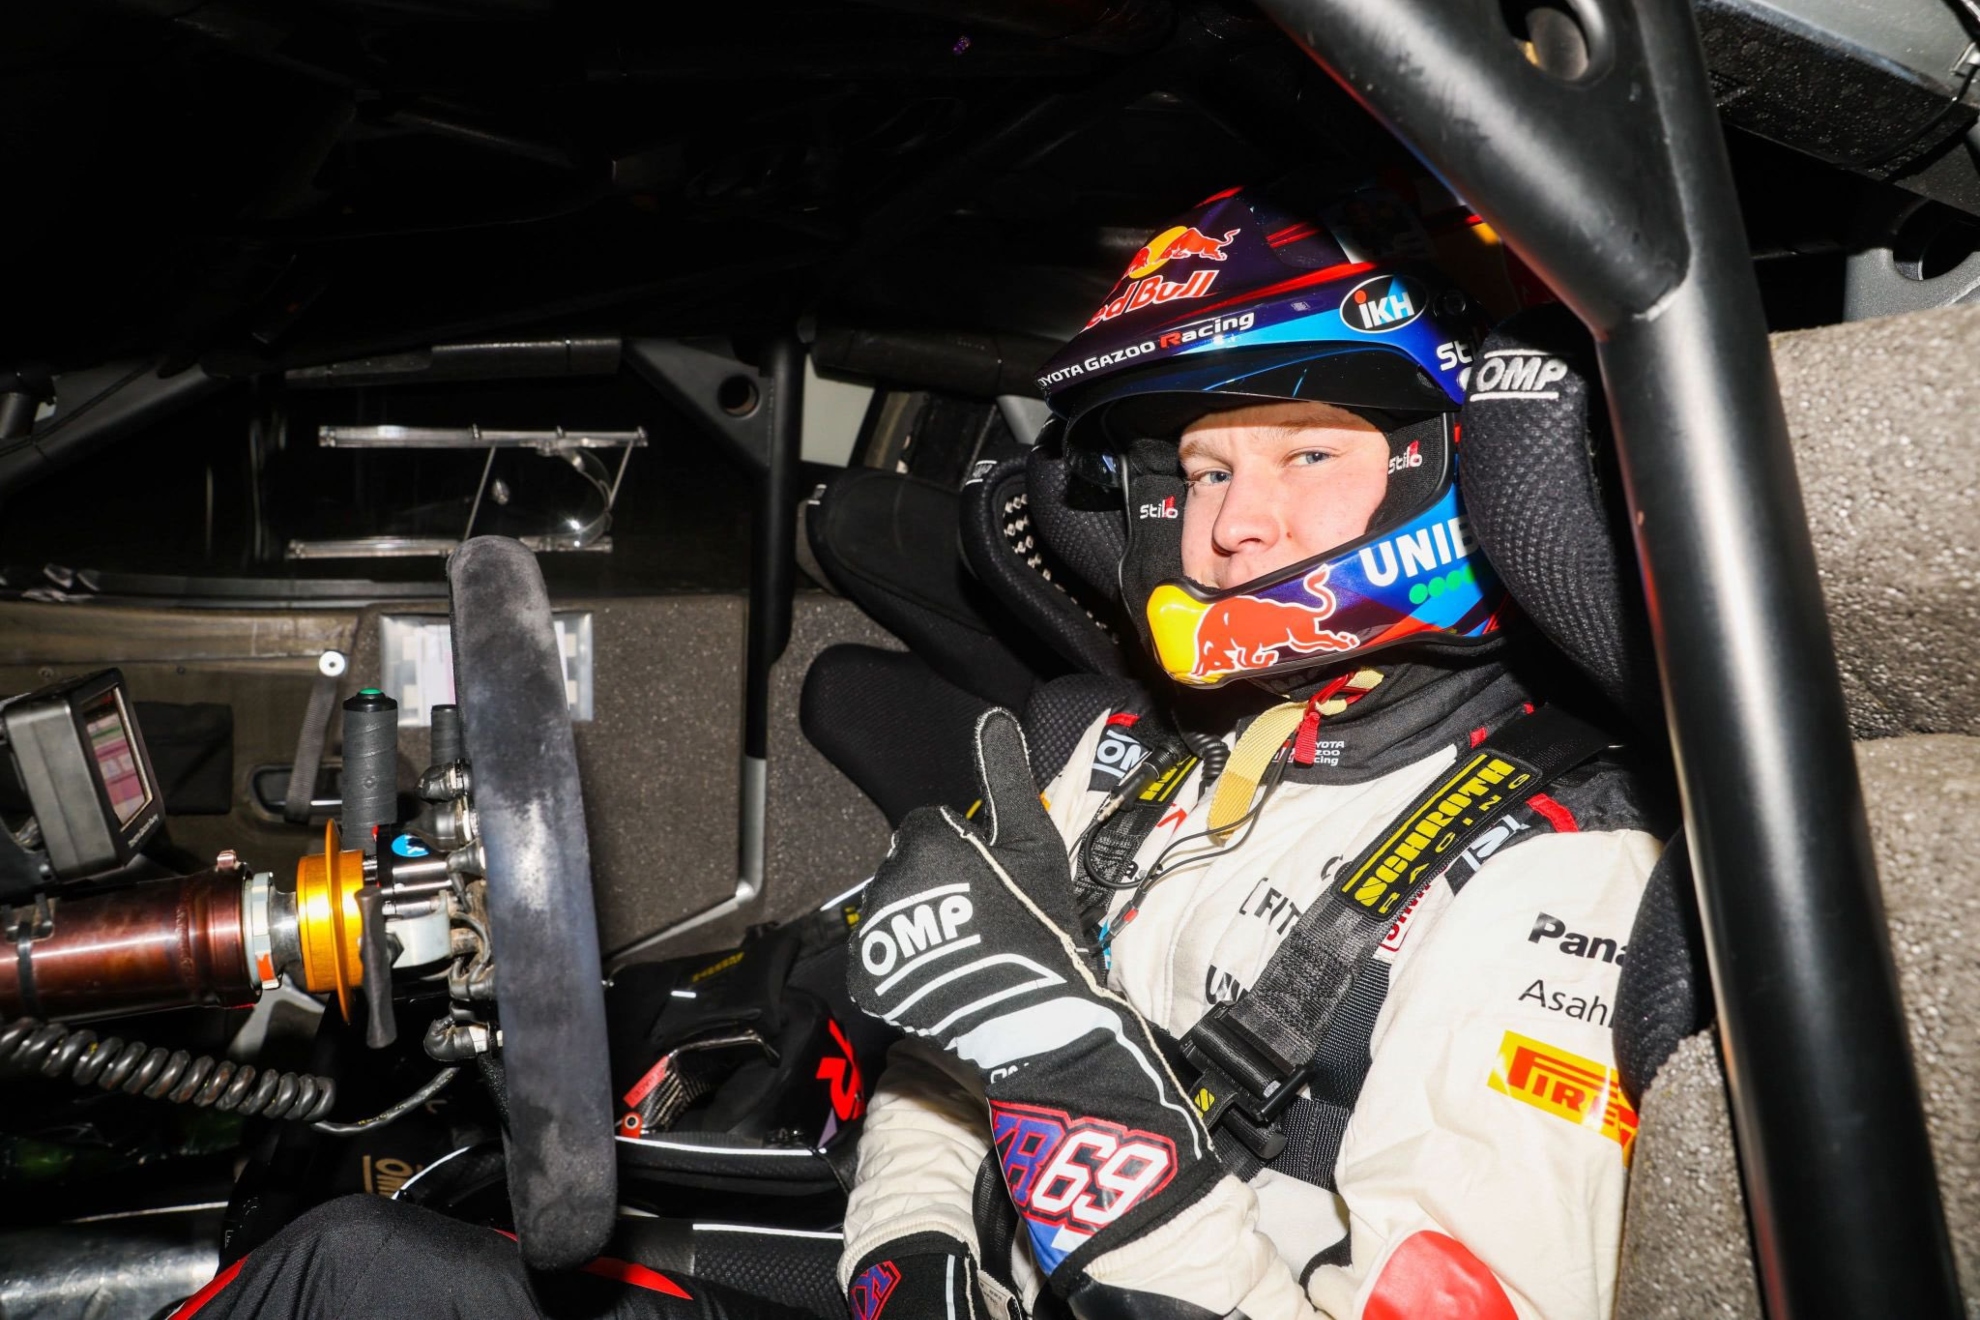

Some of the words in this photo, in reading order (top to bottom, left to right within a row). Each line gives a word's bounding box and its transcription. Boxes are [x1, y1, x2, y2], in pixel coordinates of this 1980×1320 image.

[1126, 270, 1219, 314] Bull
[1084, 341, 1156, 372] GAZOO
[1160, 312, 1255, 350] Racing
[1476, 357, 1568, 392] OMP
[1354, 758, 1516, 907] SCHROTH
[861, 894, 974, 977] OMP
